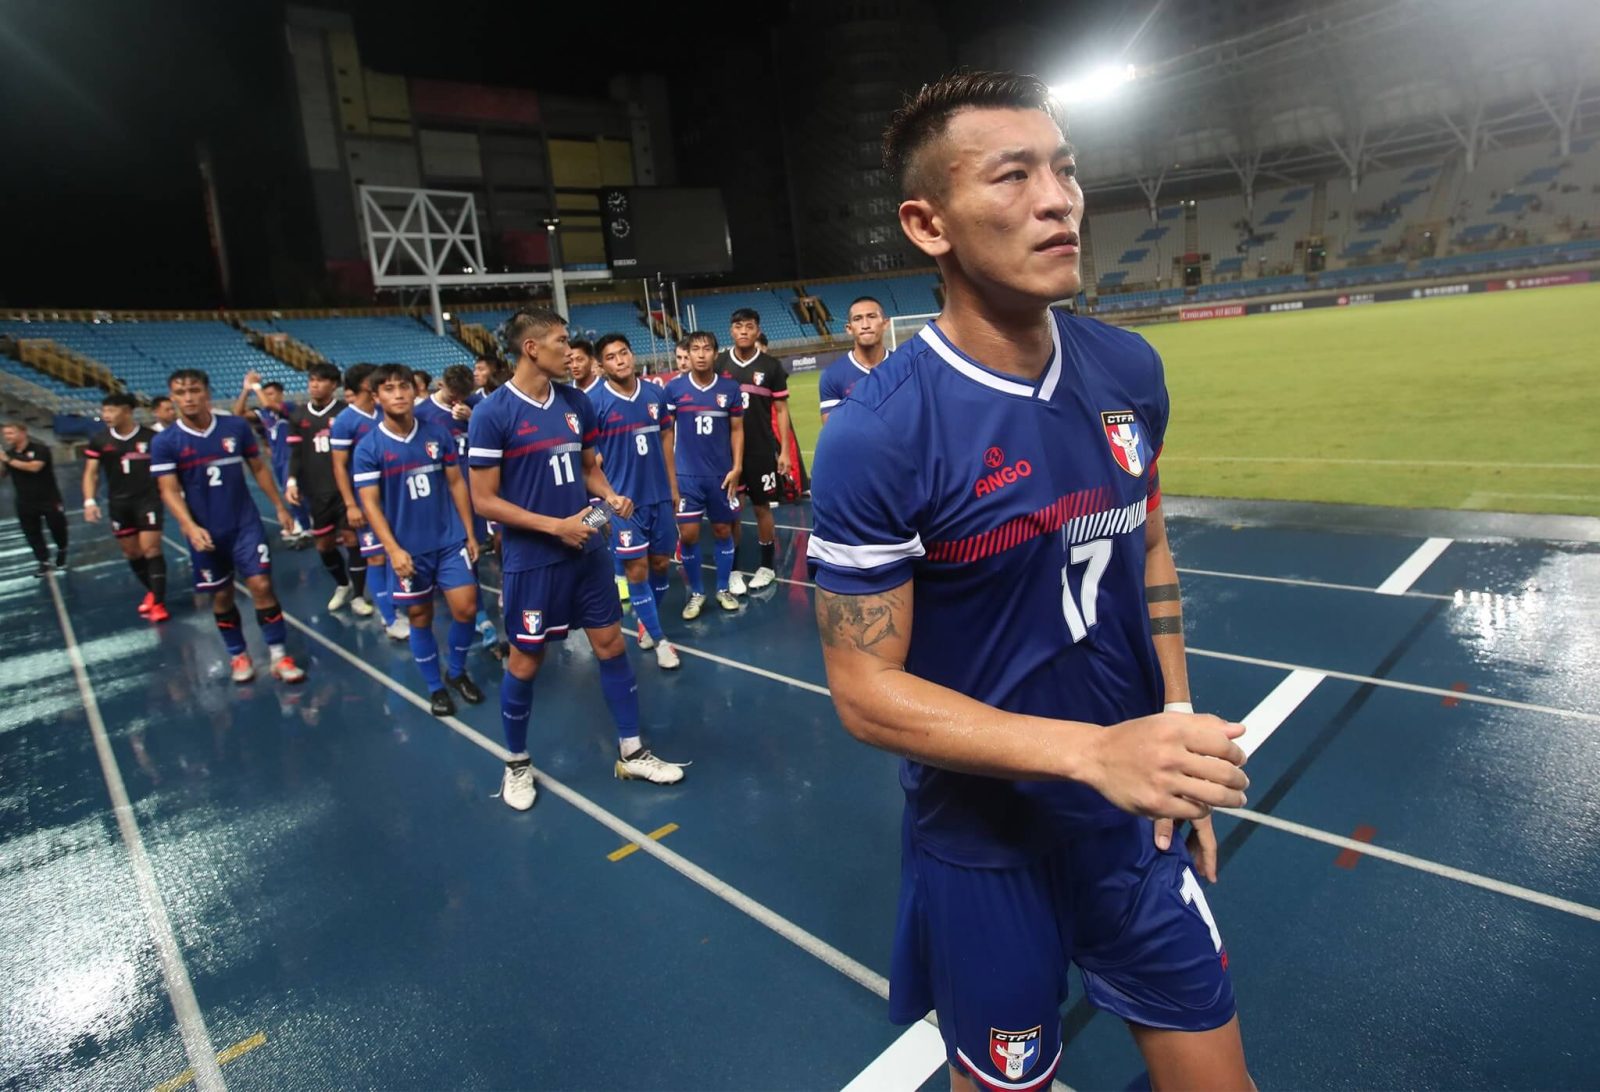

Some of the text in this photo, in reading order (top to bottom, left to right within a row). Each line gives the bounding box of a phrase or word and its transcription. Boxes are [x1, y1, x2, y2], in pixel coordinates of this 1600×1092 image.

[1182, 309, 1213, 319] Emirates
[741, 392, 750, 409] 3
[695, 415, 713, 435] 13
[1107, 414, 1135, 424] CTFA
[635, 434, 648, 456] 8
[121, 459, 130, 474] 1
[207, 466, 223, 486] 2
[550, 452, 575, 486] 11
[406, 473, 431, 500] 19
[975, 460, 1032, 498] ANGO
[146, 512, 156, 525] 1
[257, 544, 270, 563] 2
[460, 547, 472, 570] 1
[1061, 538, 1113, 643] 17
[1179, 865, 1222, 953] 1
[995, 1030, 1038, 1042] CTFA
